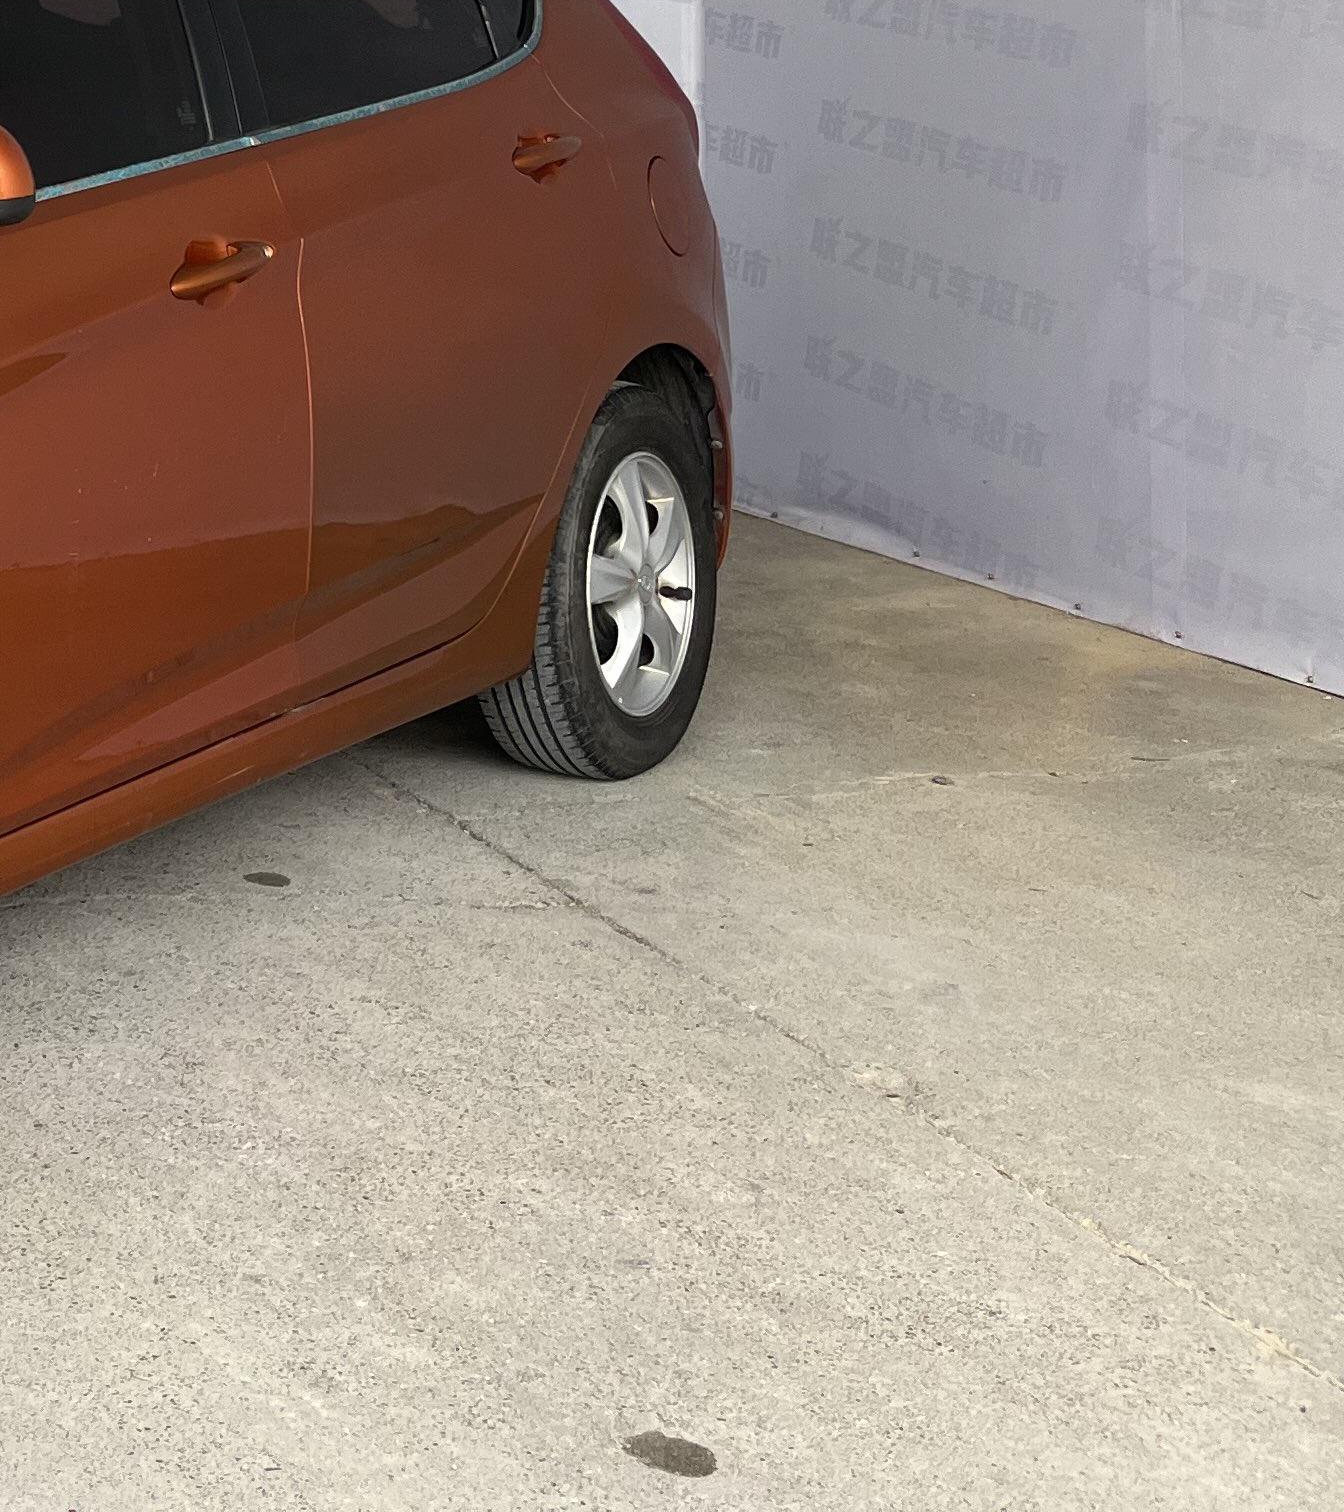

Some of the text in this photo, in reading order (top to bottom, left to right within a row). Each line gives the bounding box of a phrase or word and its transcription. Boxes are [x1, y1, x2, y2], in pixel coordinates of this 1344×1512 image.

[817, 100, 1067, 202] 联之盟汽车超市
[811, 217, 1058, 335] 联之盟汽车超市
[804, 337, 1047, 467] 联之盟汽车超市
